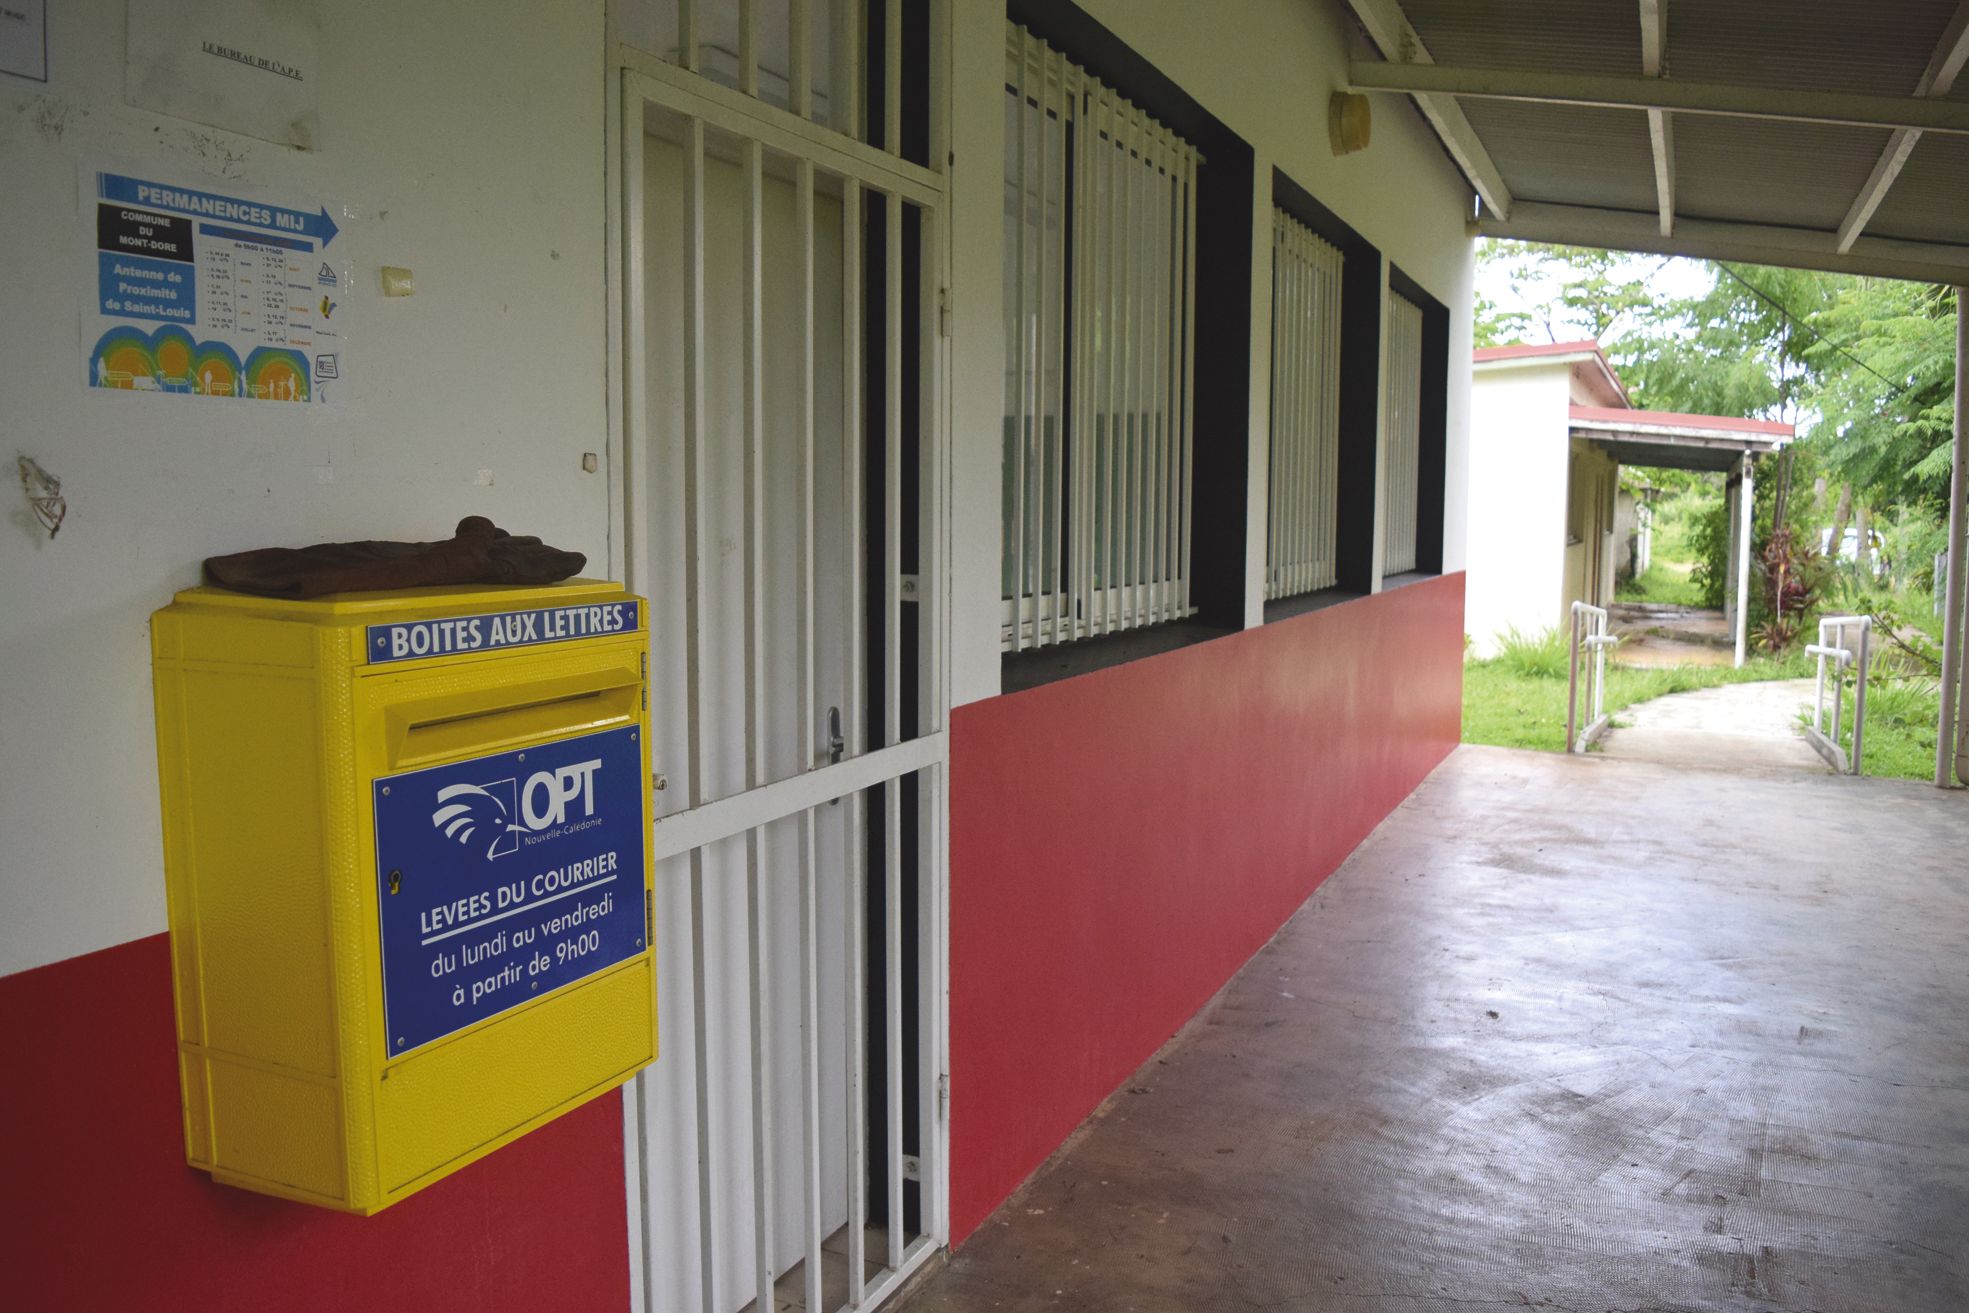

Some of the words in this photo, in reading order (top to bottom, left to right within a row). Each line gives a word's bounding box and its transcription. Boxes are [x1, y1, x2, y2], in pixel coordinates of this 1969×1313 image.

[202, 41, 214, 52] LE
[217, 46, 255, 65] BUREAU
[258, 58, 270, 69] DE
[121, 211, 171, 227] COMMUNE
[137, 185, 271, 225] PERMANENCES
[276, 212, 304, 231] MIJ
[119, 235, 177, 252] MONT-DORE
[139, 226, 153, 236] DU
[113, 264, 164, 281] Antenne
[167, 272, 182, 283] de
[119, 282, 177, 299] Proximité
[105, 298, 120, 310] de
[124, 301, 191, 318] Saint-Louis
[391, 619, 482, 657] BOITES
[489, 613, 538, 647] AUX
[544, 604, 624, 639] LETTRES
[522, 759, 601, 830] OPT
[525, 818, 602, 846] Nouvelle-Calédonie
[420, 891, 491, 934] LEVEES
[497, 881, 525, 909] DU
[531, 851, 617, 896] COURRIER
[431, 953, 456, 978] du
[462, 930, 507, 967] lundi
[512, 927, 535, 948] au
[541, 893, 613, 937] vendredi
[452, 985, 464, 1006] à
[472, 962, 523, 1005] partir
[528, 952, 550, 976] de
[556, 930, 599, 965] 9h00
